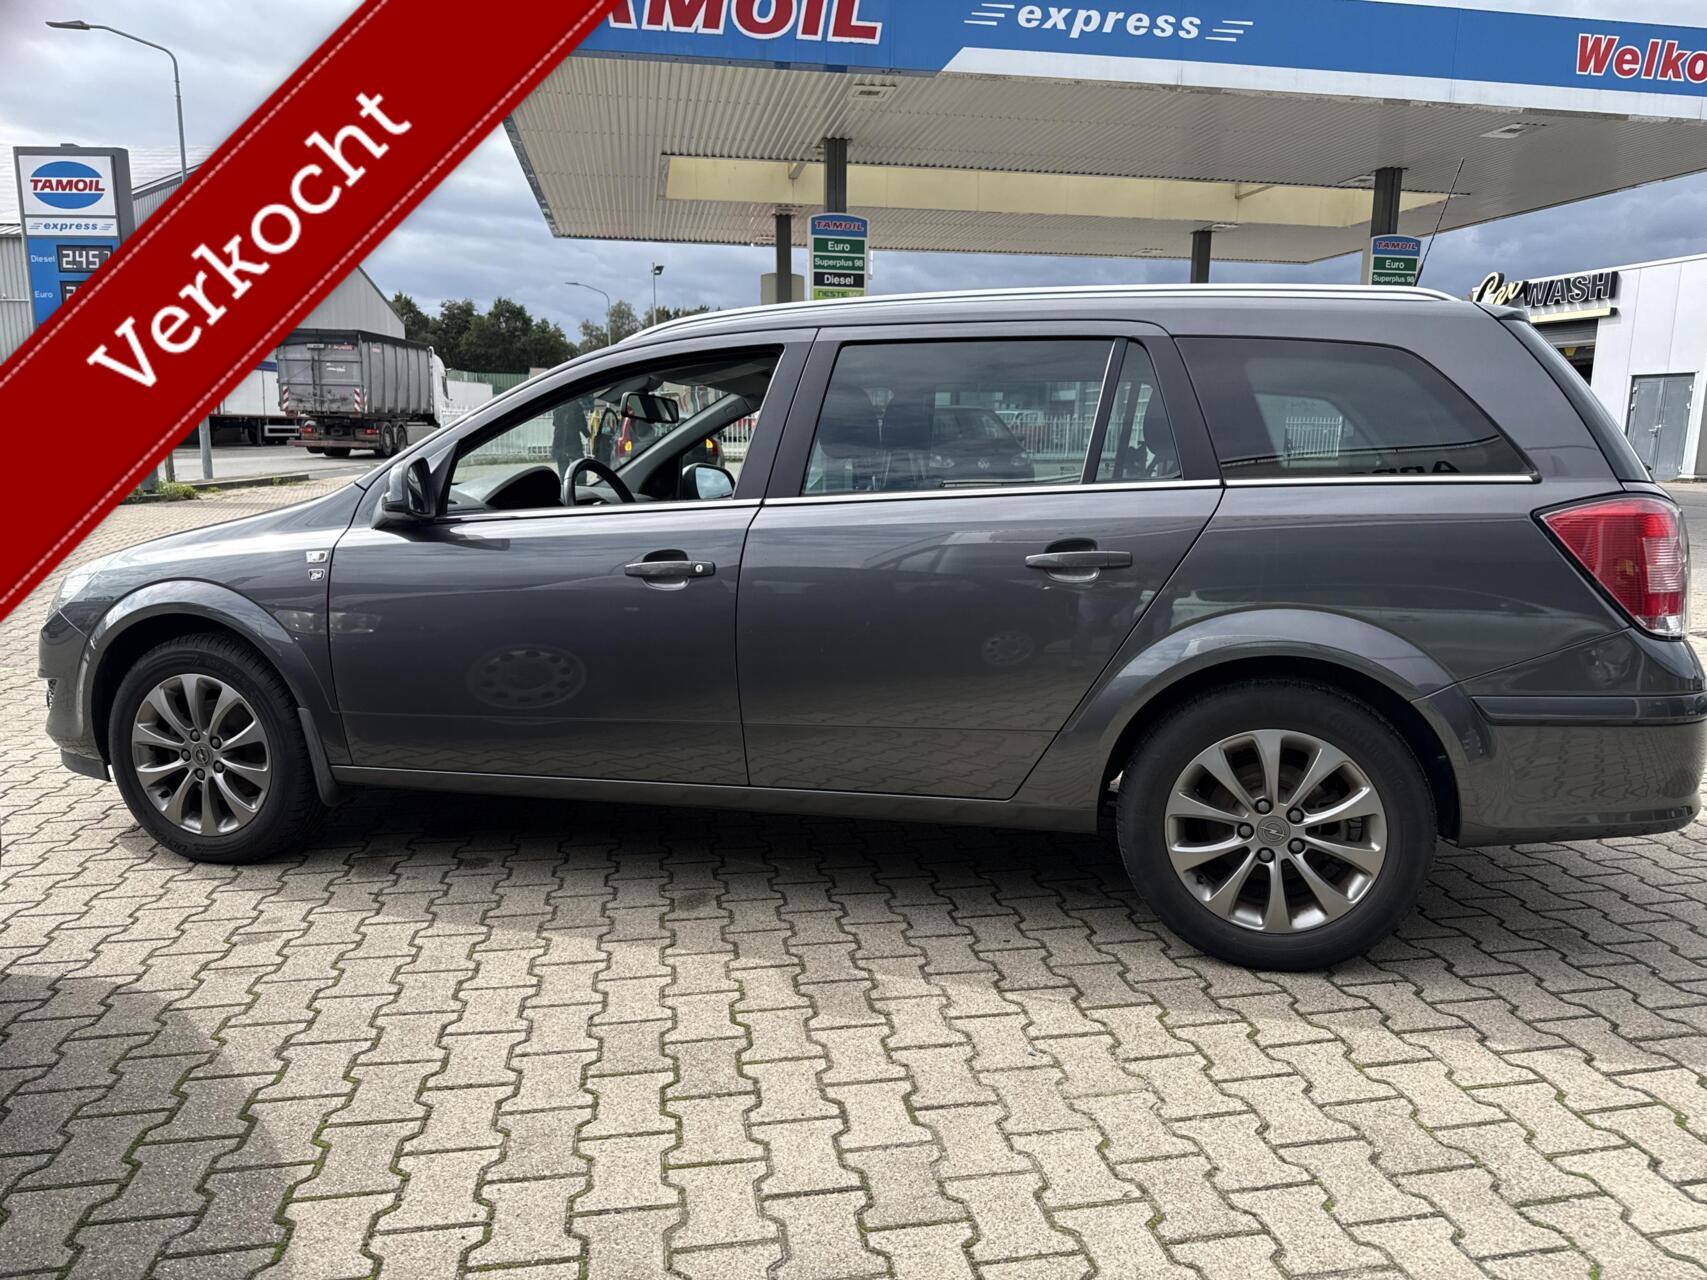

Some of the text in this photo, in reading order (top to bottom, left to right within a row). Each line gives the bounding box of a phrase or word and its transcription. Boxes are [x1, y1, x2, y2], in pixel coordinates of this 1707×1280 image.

[1017, 4, 1201, 39] express
[1576, 33, 1707, 84] Welko
[30, 178, 105, 192] TAMOIL
[43, 221, 98, 231] express
[815, 221, 864, 231] TAMOIL
[827, 241, 850, 251] Euro
[1376, 240, 1418, 250] TAMOIL
[30, 255, 56, 263] Diesel
[814, 257, 852, 267] Superplus
[1385, 260, 1405, 269] Euro
[824, 274, 854, 285] Diesel
[1373, 274, 1405, 283] Superplus
[34, 290, 54, 299] Euro
[1523, 272, 1615, 307] WASH
